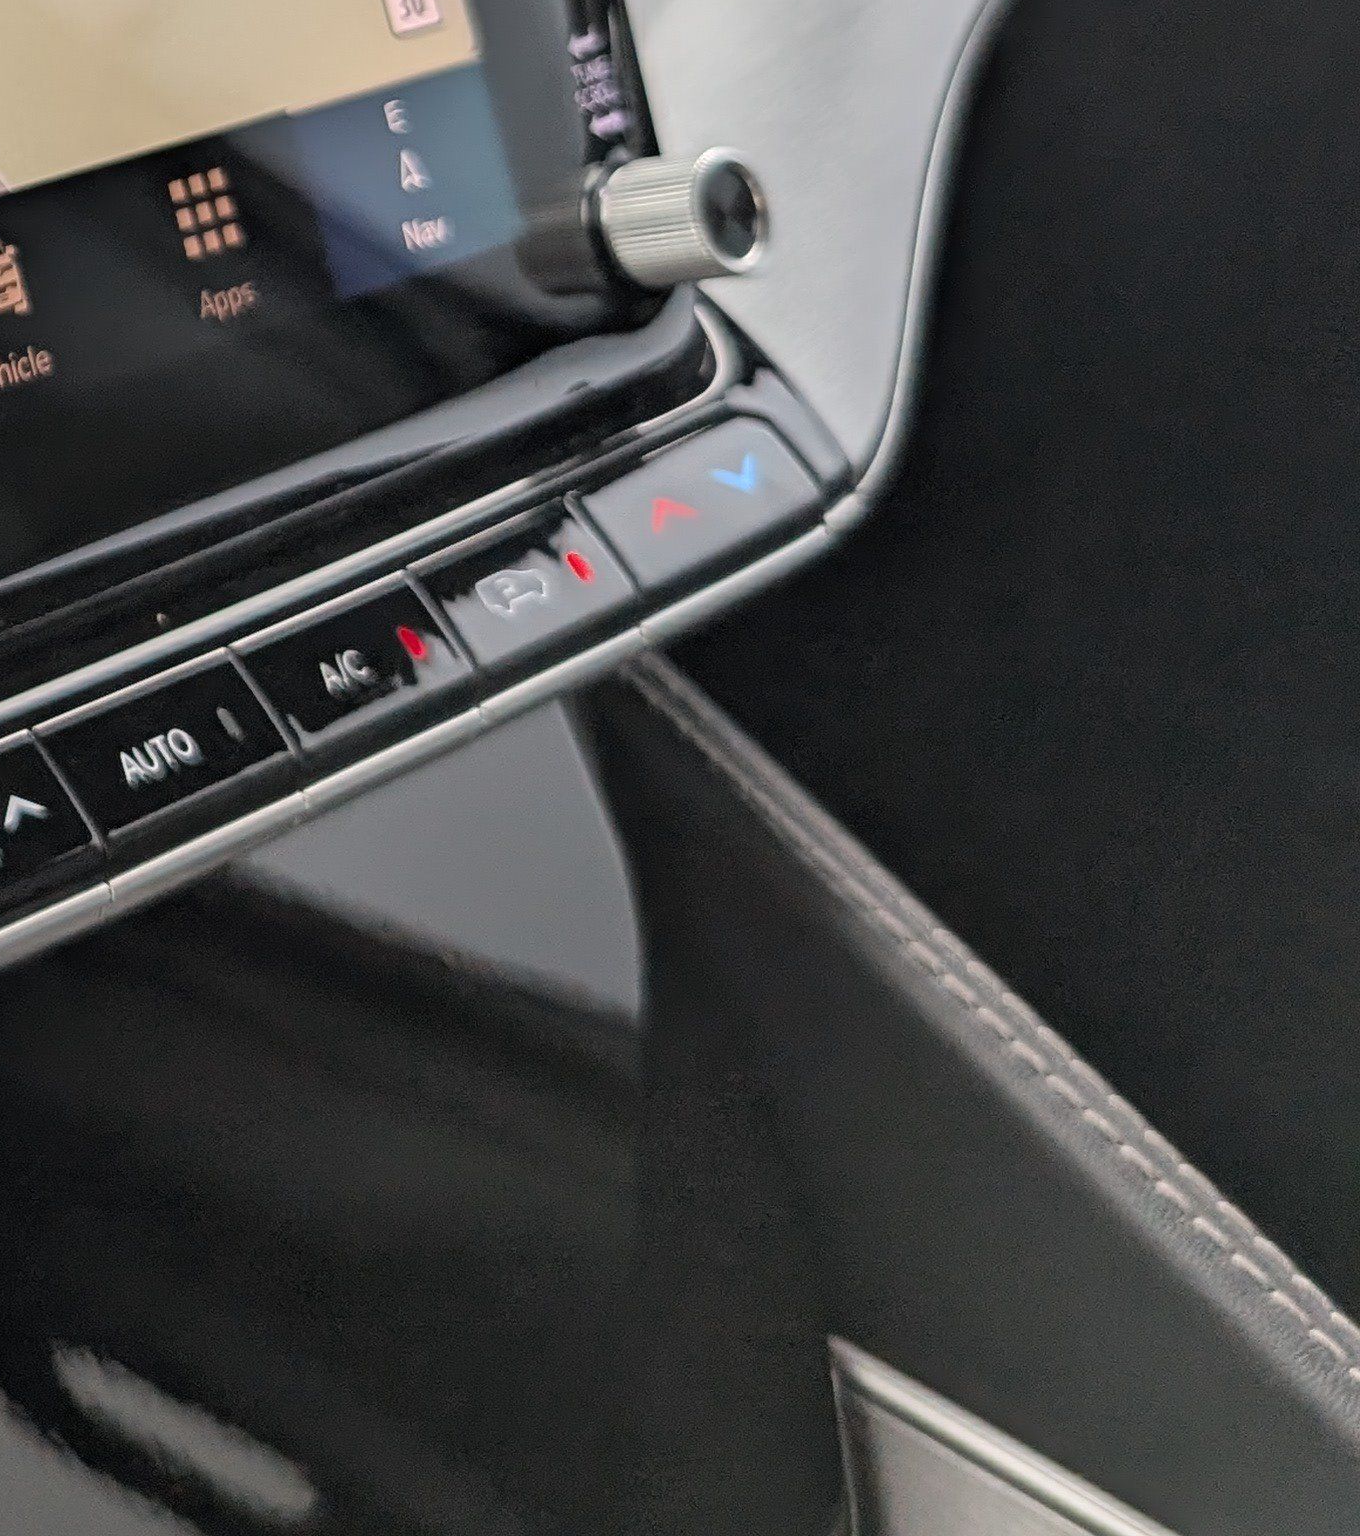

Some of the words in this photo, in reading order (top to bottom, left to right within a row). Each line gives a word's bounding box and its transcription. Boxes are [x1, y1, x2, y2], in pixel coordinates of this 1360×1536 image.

[401, 216, 451, 252] Nav
[200, 280, 260, 323] Apps
[319, 649, 375, 698] A/C
[120, 727, 200, 789] AUTO
